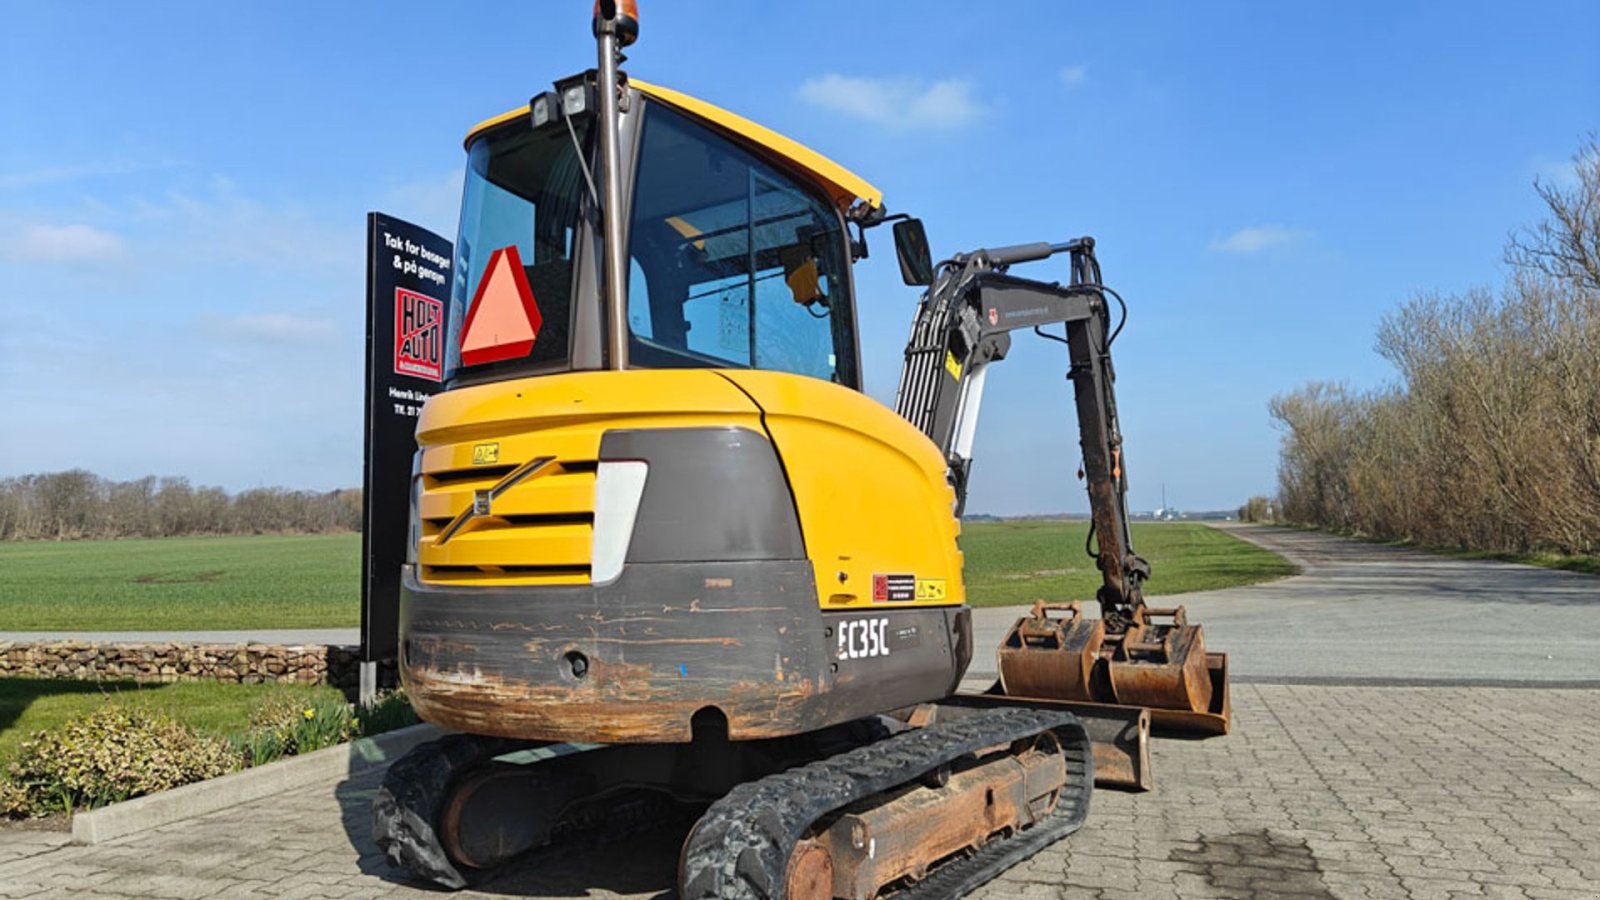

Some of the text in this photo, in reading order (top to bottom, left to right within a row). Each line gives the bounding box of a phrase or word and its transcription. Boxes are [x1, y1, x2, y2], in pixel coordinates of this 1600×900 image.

[384, 232, 403, 251] Tak
[405, 239, 420, 255] for
[393, 254, 403, 269] &
[402, 294, 439, 336] HOLT
[400, 324, 438, 364] AUTO
[388, 386, 413, 401] Henrik
[838, 618, 890, 660] EC35C
